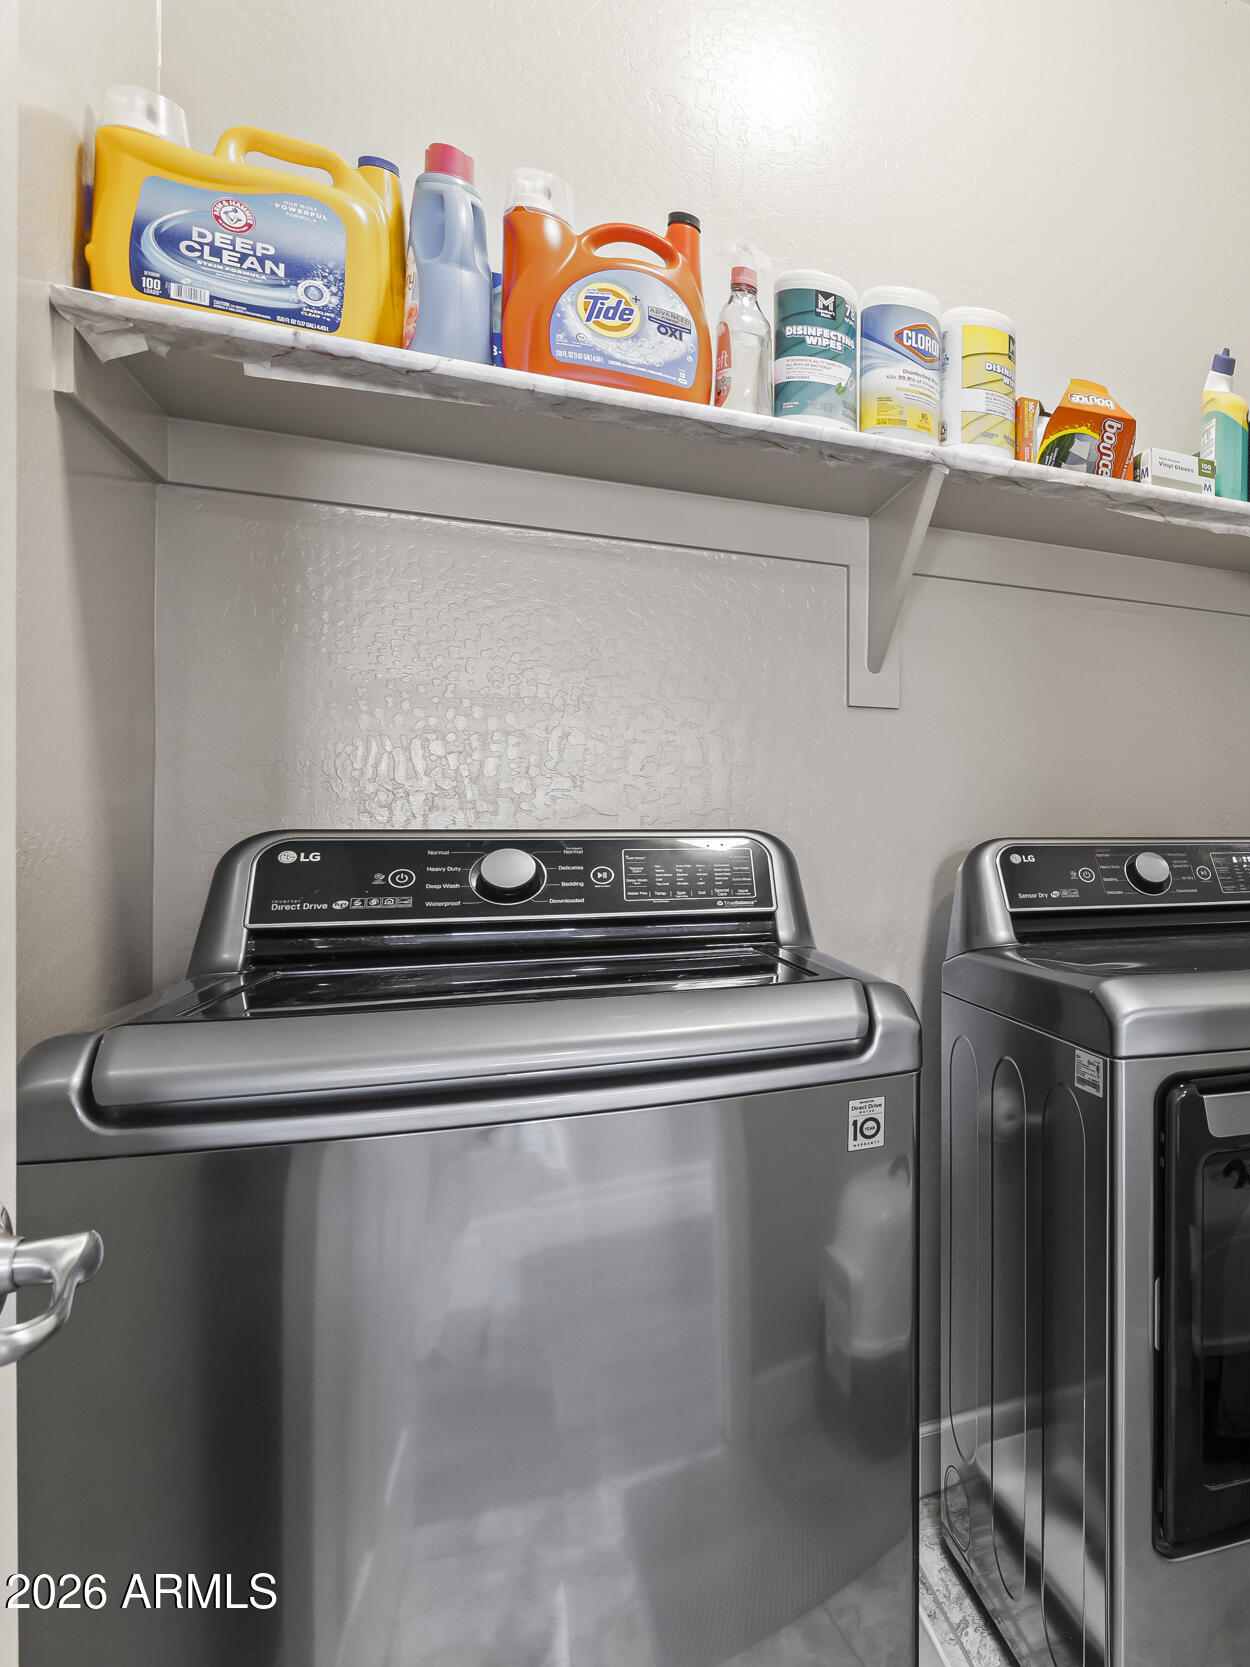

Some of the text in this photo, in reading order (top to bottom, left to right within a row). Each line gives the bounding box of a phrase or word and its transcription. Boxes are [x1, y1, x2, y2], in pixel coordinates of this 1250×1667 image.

[274, 202, 328, 221] POWERFUL
[285, 211, 318, 223] FORMULA
[191, 225, 276, 257] DEEP
[179, 240, 285, 278] CLEAN
[196, 260, 225, 270] STAIN
[224, 264, 267, 280] FORMULA
[141, 276, 161, 290] 100
[300, 311, 321, 319] CLEAN
[583, 295, 635, 323] Tide
[650, 308, 690, 326] ADVANCED
[657, 324, 684, 341] OXI
[785, 325, 856, 350] DISINFECTING
[805, 335, 843, 352] WIPES
[902, 329, 940, 356] CLORO
[1069, 392, 1116, 410] bounce
[1098, 418, 1123, 477] bounce
[1140, 466, 1149, 479] M
[1158, 461, 1174, 469] Vinyl
[1174, 464, 1194, 474] Gloves
[1201, 463, 1212, 471] 100
[1203, 483, 1212, 492] M
[300, 852, 321, 862] LG
[1022, 854, 1036, 863] LG
[271, 903, 301, 911] Direct
[302, 902, 328, 910] Drive
[425, 900, 461, 908] Waterproof
[852, 1117, 881, 1141] 10
